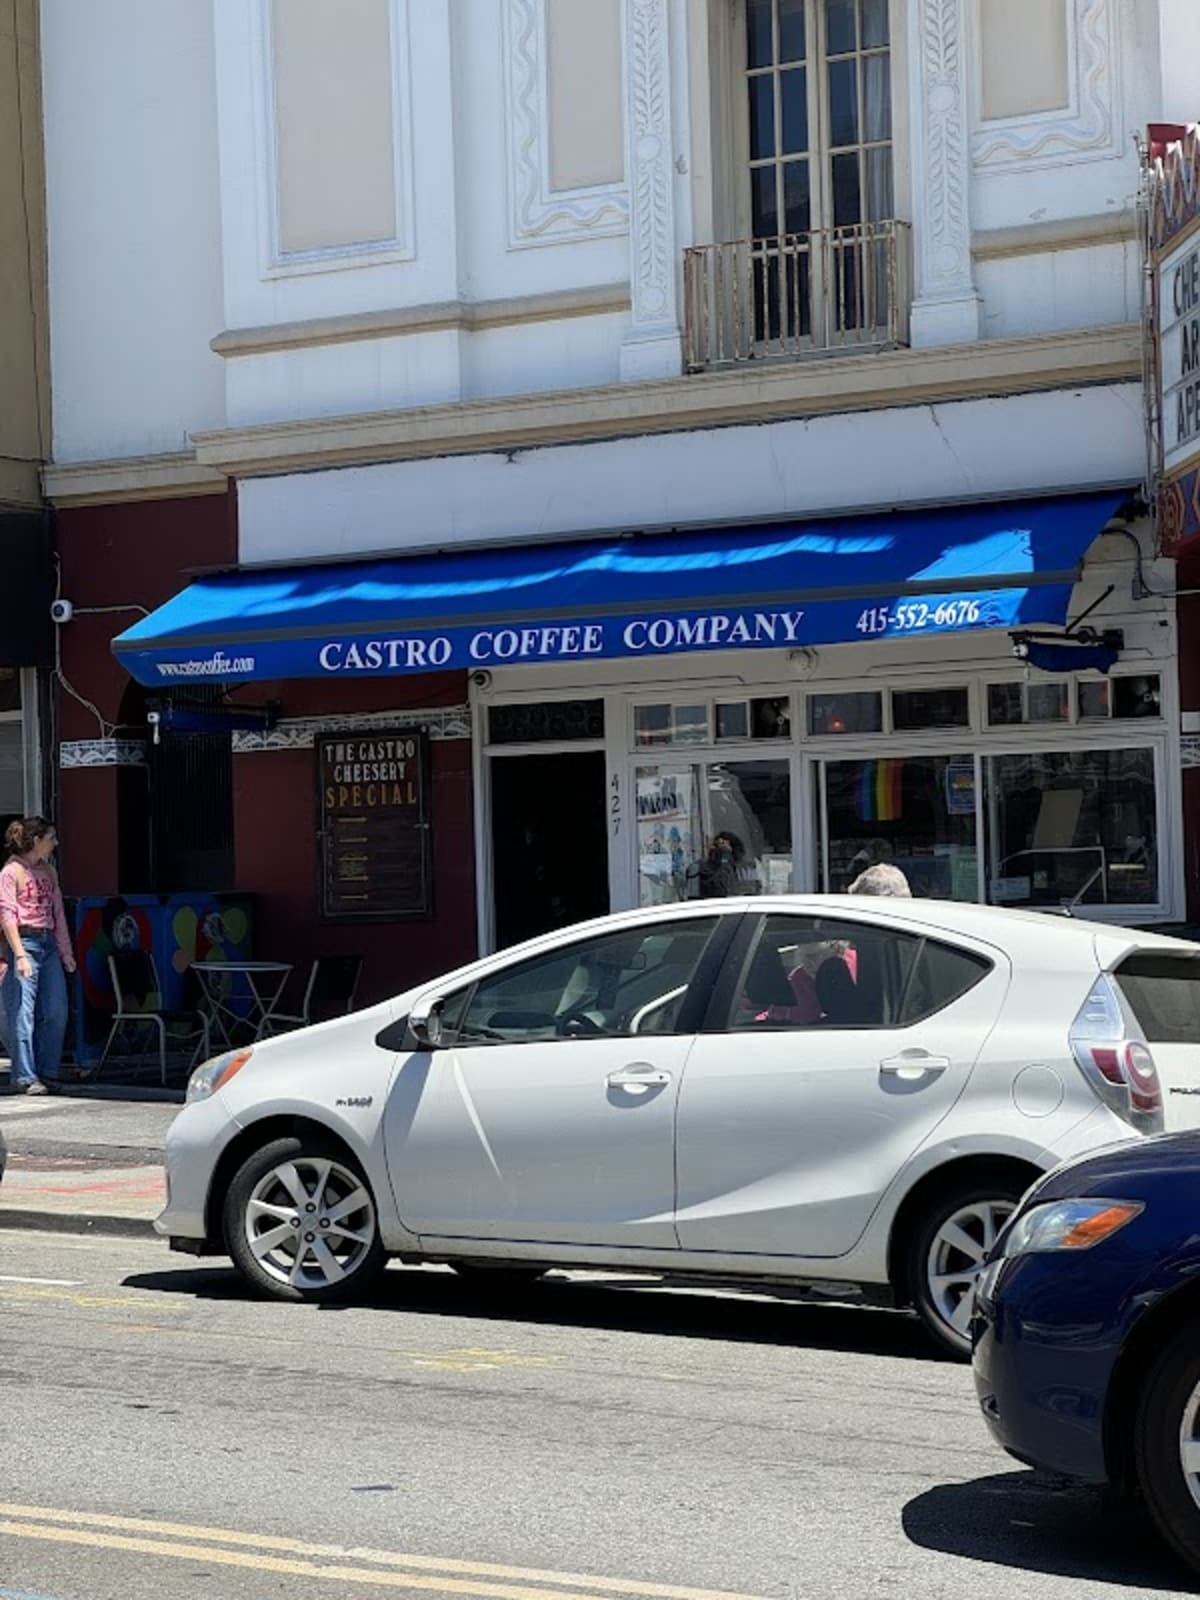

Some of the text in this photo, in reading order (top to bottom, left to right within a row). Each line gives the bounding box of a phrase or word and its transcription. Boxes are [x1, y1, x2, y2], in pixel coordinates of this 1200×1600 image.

[856, 600, 978, 633] 415-552-6676
[319, 611, 805, 672] CASTRO COFFEE COMPANY
[325, 740, 415, 762] THE CASTRO
[333, 761, 406, 783] CHEESERY
[325, 782, 417, 808] SPECIAL
[611, 773, 622, 836] 427
